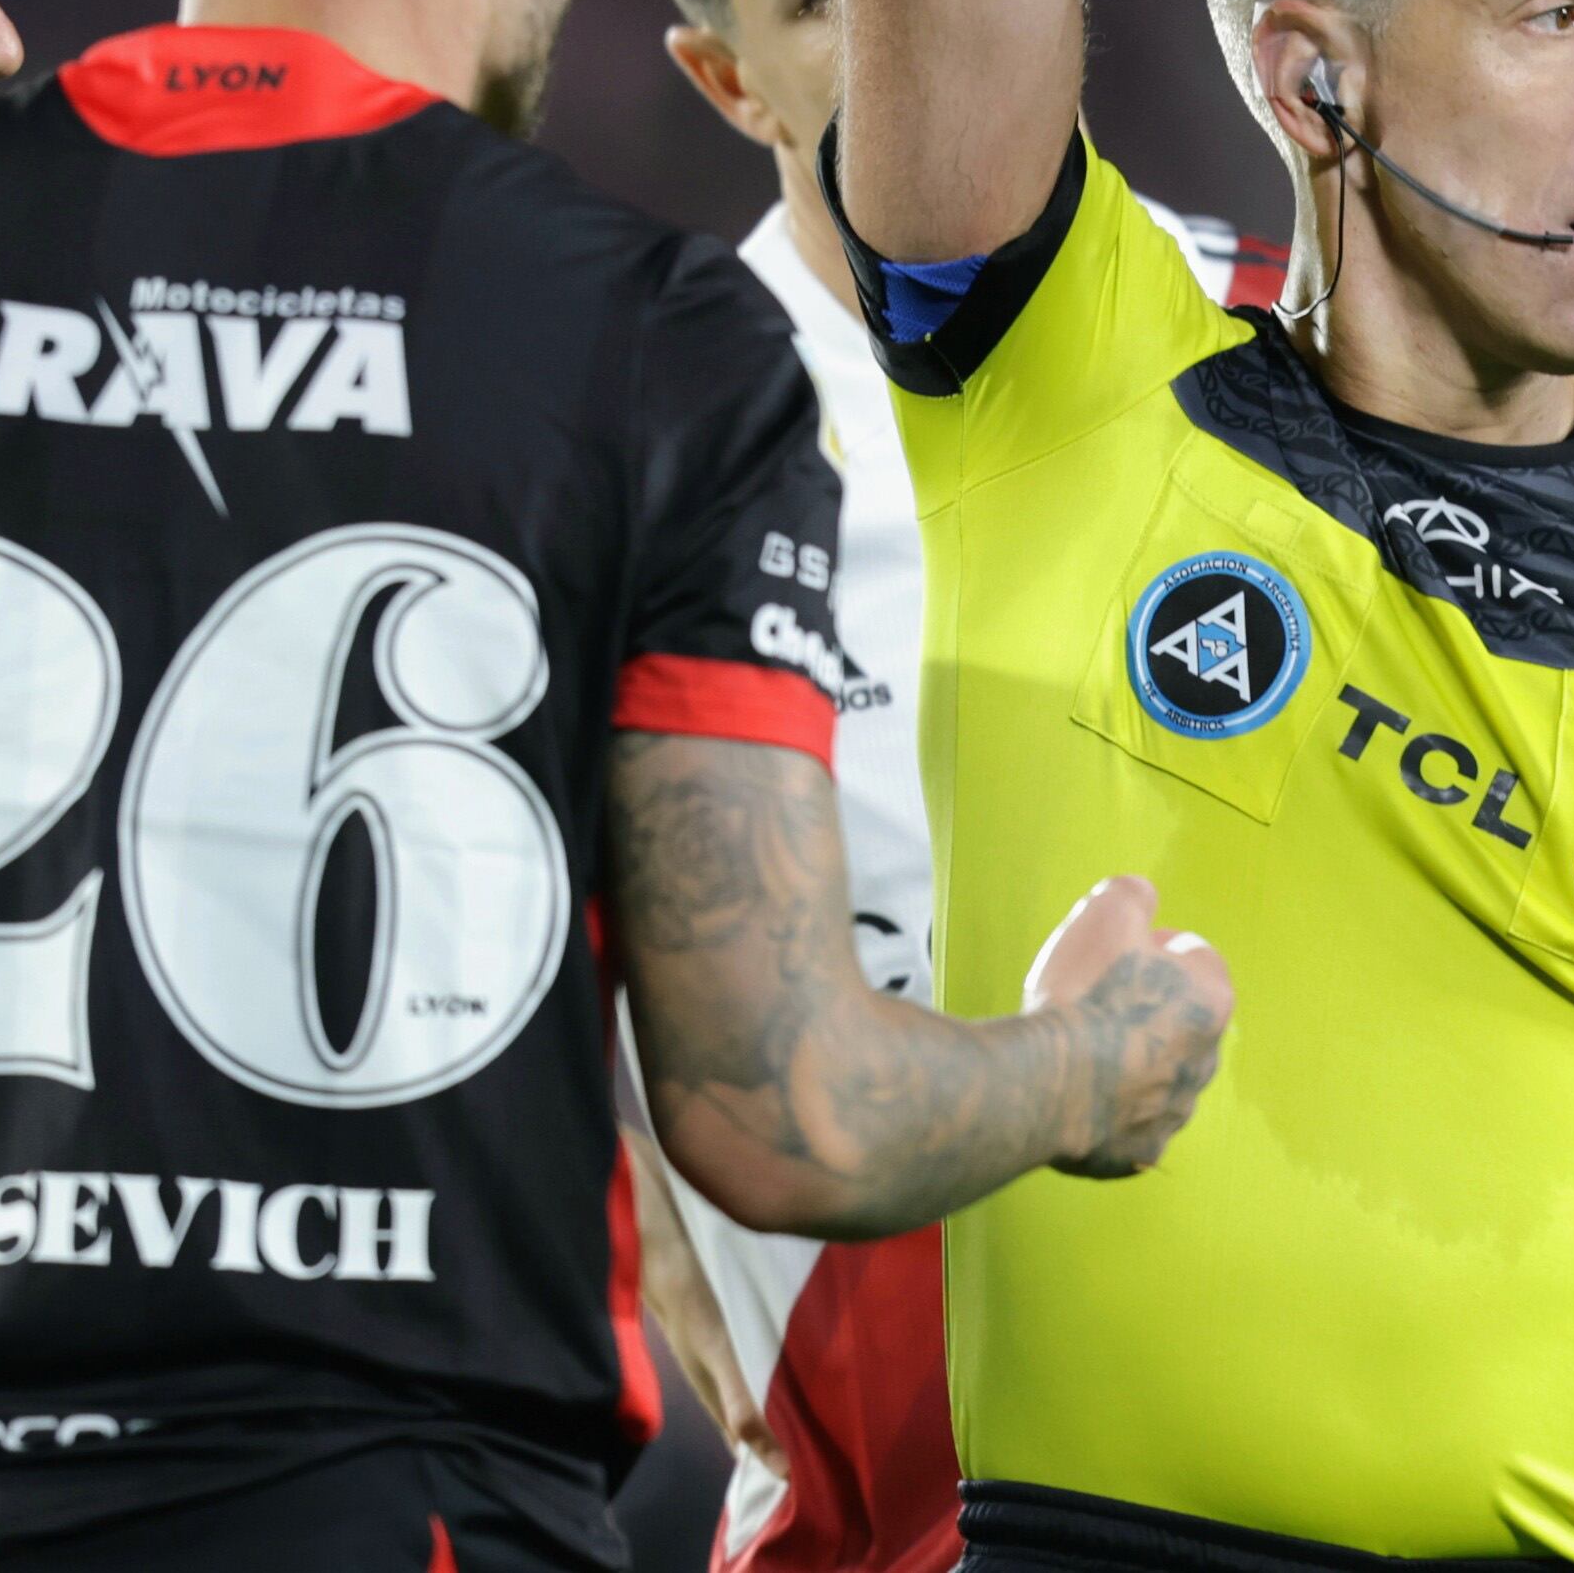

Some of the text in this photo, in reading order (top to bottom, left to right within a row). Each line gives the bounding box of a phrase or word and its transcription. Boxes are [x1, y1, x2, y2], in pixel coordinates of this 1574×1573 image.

[163, 62, 288, 93] LYON
[129, 276, 407, 321] Motocicletas
[1162, 558, 1249, 591] ASOCIACION
[1260, 576, 1301, 654] ARGENTINA
[1164, 707, 1226, 732] ARBITROS
[1337, 682, 1533, 852] TCL
[408, 994, 489, 1017] LYON
